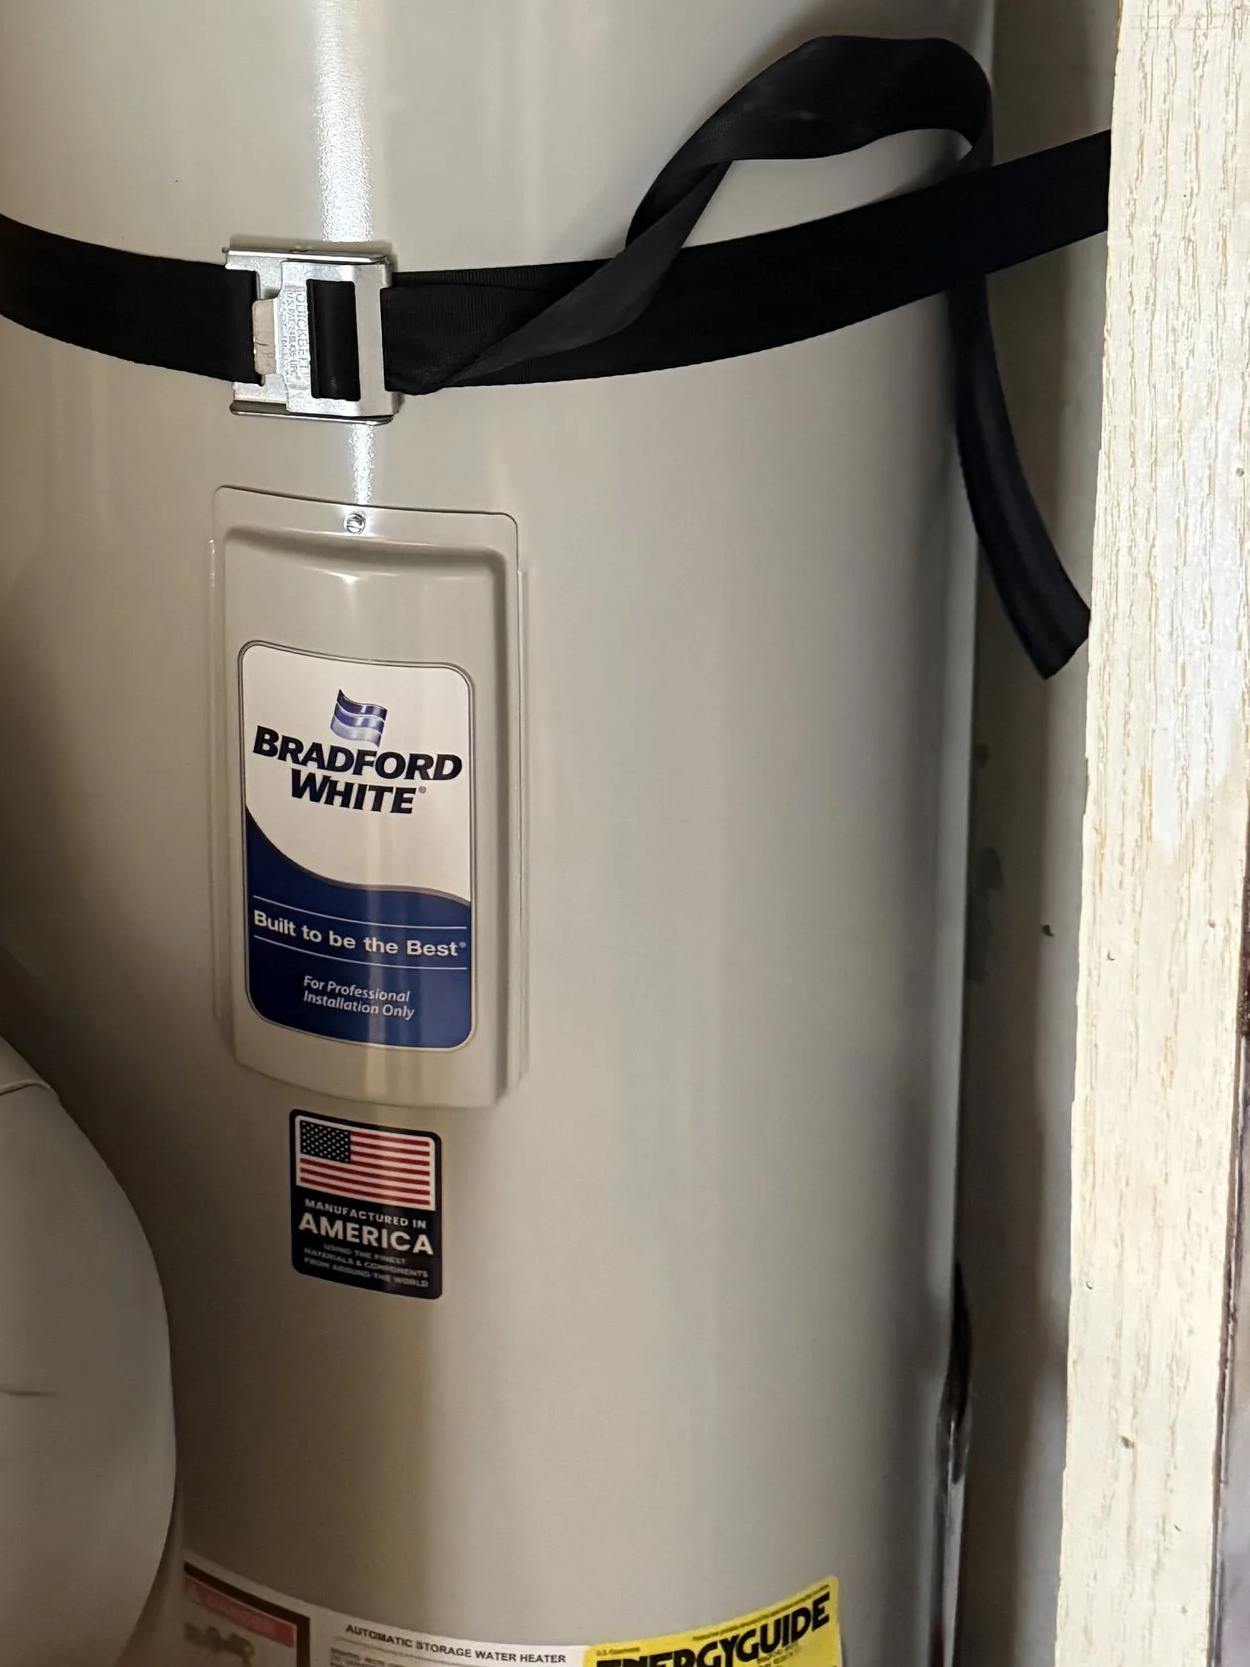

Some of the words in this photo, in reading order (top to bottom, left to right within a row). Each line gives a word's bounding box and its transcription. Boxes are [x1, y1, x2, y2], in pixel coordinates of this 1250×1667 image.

[252, 725, 463, 781] BRADFORD
[291, 768, 417, 814] WHITE
[253, 909, 297, 936] Built
[301, 924, 323, 943] to
[328, 930, 356, 949] be
[363, 937, 399, 954] the
[406, 940, 458, 956] Best
[303, 975, 325, 990] For
[327, 981, 410, 1003] Professional
[303, 990, 380, 1014] Installation
[382, 1003, 415, 1020] Only
[304, 1198, 409, 1227] MANUFACTURED
[412, 1219, 427, 1230] IN
[298, 1212, 434, 1255] AMERICA
[304, 1247, 354, 1265] MATERIALS
[304, 1256, 330, 1269] FROM
[373, 1271, 392, 1282] THE
[393, 1275, 429, 1287] WORLD
[354, 1249, 373, 1260] THE
[345, 1623, 413, 1648] AUTOMATIC
[415, 1641, 472, 1658] STORAGE
[475, 1650, 517, 1663] WATER
[519, 1653, 567, 1664] HEATER
[596, 1591, 830, 1667] ERGYGUIDE
